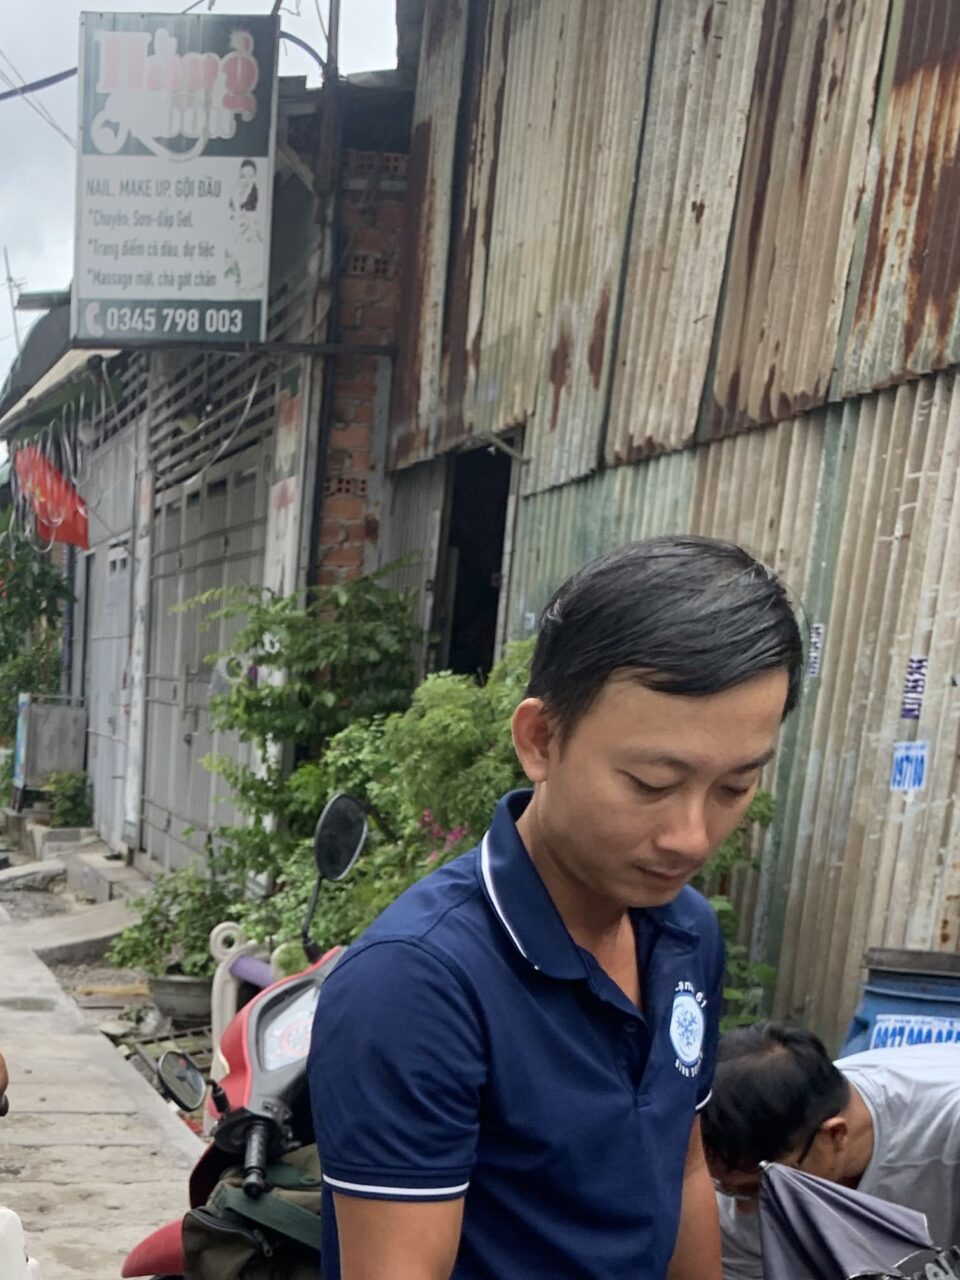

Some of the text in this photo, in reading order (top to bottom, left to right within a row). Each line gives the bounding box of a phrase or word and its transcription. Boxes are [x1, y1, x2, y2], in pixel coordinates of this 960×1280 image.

[119, 178, 152, 197] MAKE
[106, 307, 243, 333] 0345 798 003
